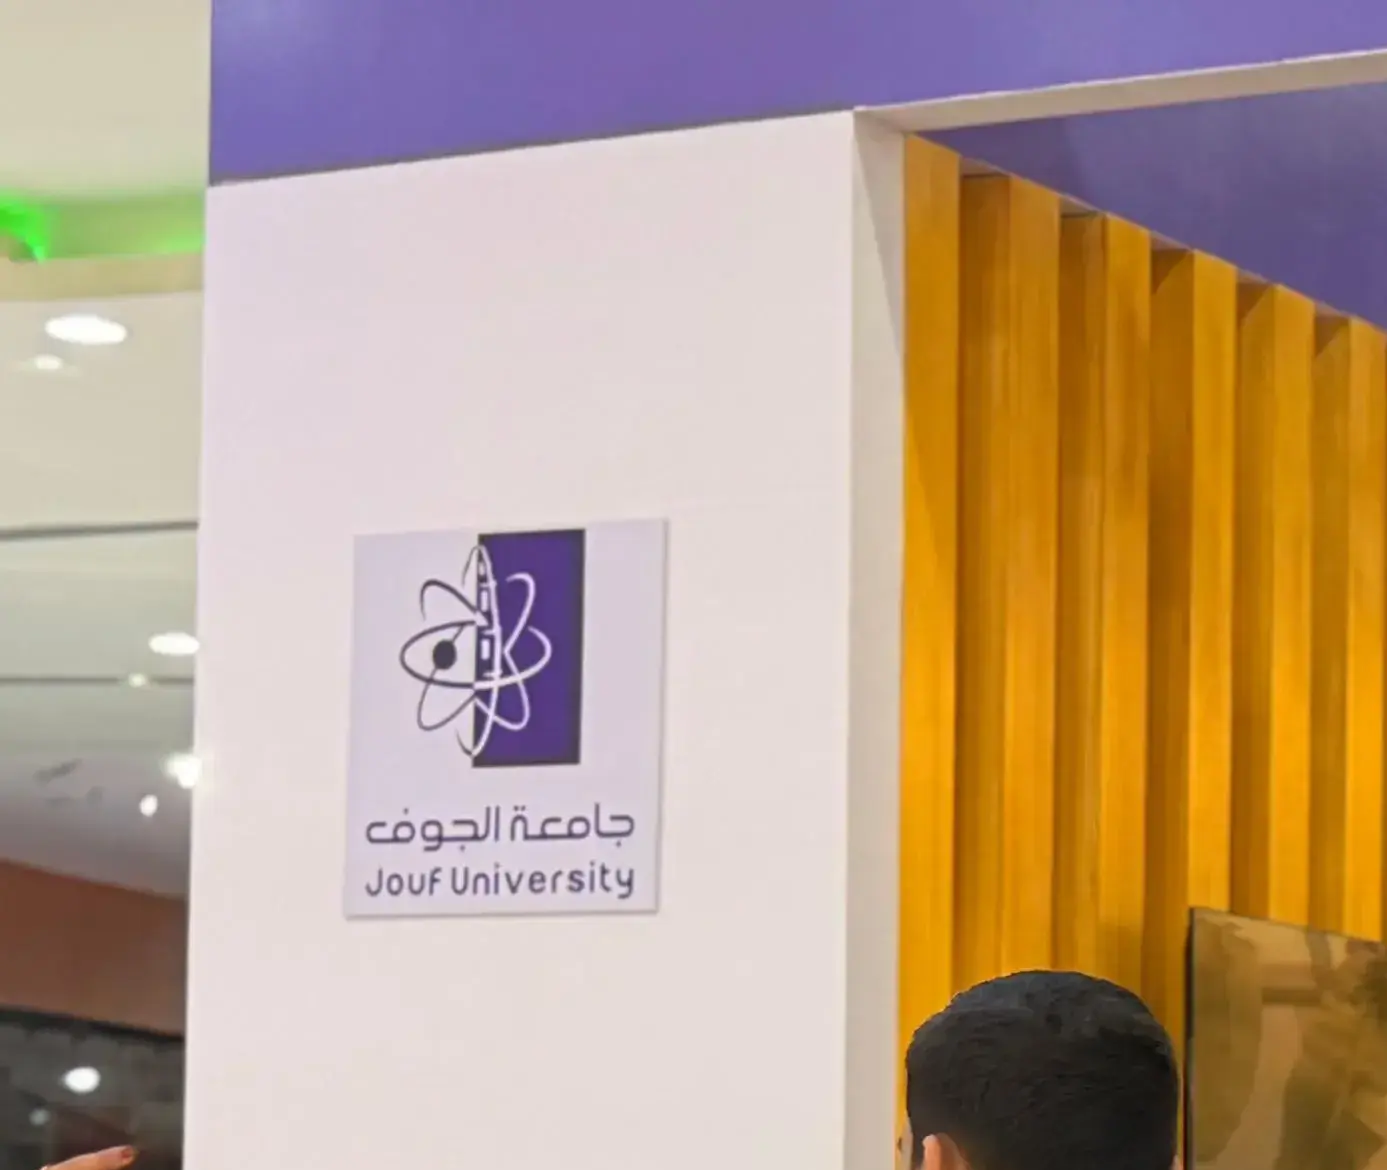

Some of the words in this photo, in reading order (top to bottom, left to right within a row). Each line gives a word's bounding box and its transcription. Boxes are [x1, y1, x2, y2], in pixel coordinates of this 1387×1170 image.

[366, 806, 500, 852] الجوف
[510, 803, 635, 847] جامعة
[365, 867, 442, 897] Jouf
[451, 861, 634, 900] University
